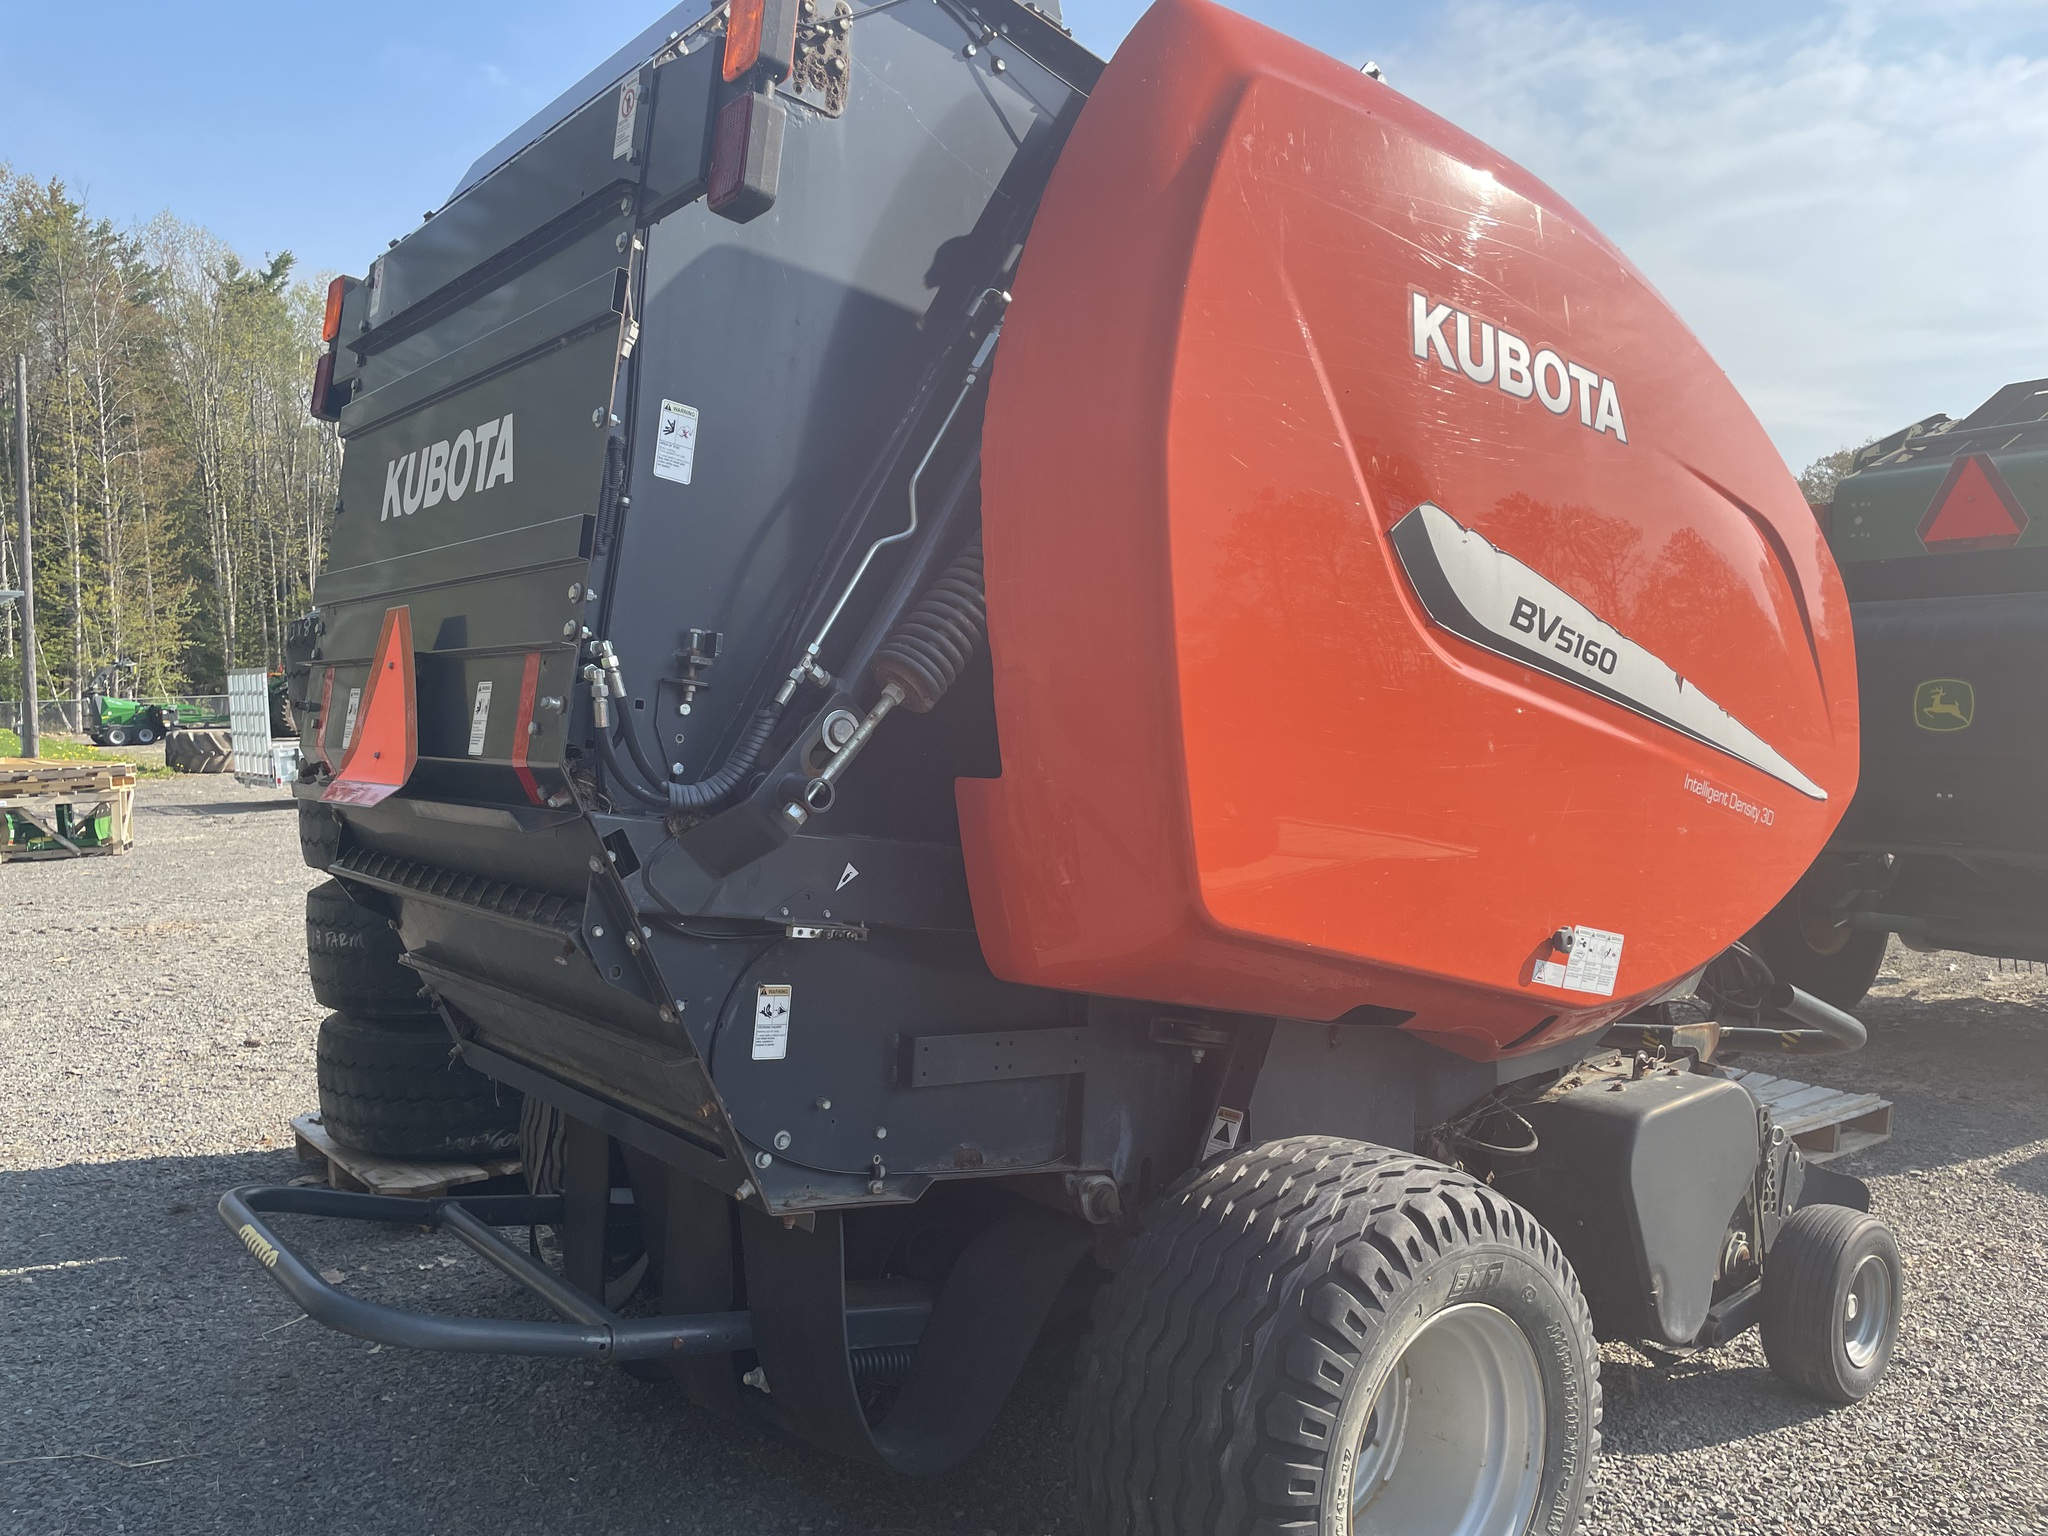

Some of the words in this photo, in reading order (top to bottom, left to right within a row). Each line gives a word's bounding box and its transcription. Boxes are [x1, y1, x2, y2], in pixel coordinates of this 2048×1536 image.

[1412, 291, 1629, 446] KUBOTA
[672, 405, 696, 418] WARNING
[381, 413, 514, 522] KUBOTA
[1509, 596, 1618, 675] BV5160
[1683, 773, 1729, 806] Intelligent
[1729, 793, 1761, 824] Density
[1760, 807, 1775, 826] 3D
[325, 931, 365, 949] FARM
